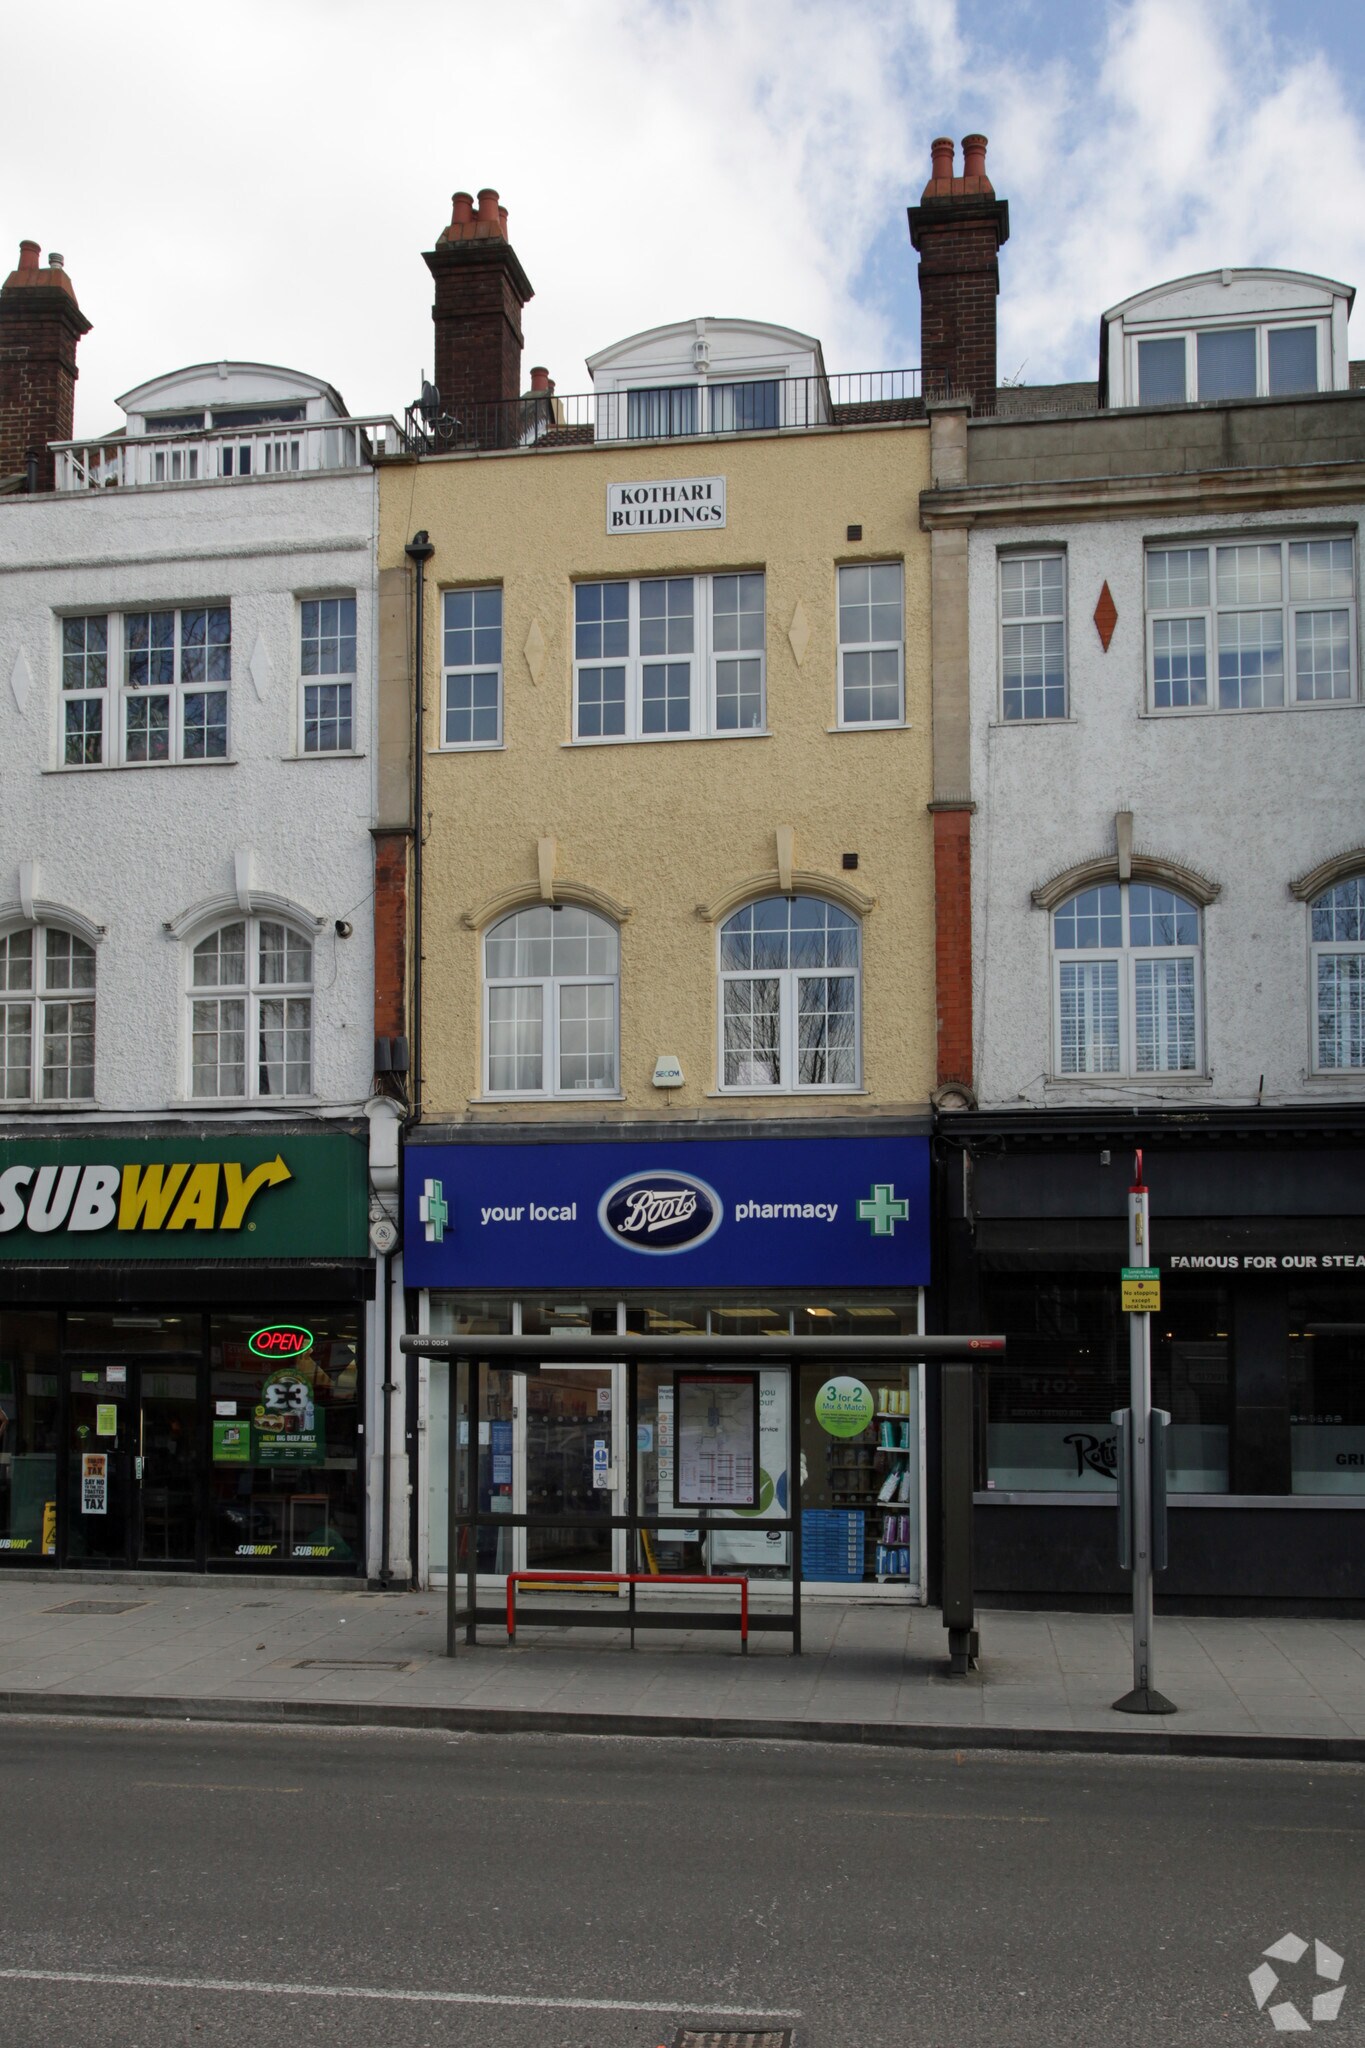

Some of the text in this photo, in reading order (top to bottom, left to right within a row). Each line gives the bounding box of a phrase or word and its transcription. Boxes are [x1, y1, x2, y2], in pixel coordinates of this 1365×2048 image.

[621, 484, 712, 505] KOTHARI
[612, 505, 722, 526] BUILDINGS
[655, 1070, 680, 1078] SECOM
[0, 1154, 291, 1233] SUBWAY
[480, 1189, 839, 1233] your local Boots pharmacy
[1170, 1255, 1365, 1268] FAMOUS FOR OUR STEA
[257, 1332, 304, 1351] OPEN
[265, 1383, 309, 1409] £3
[760, 1389, 776, 1398] you
[827, 1386, 863, 1402] 3 for 2
[845, 1403, 867, 1411] Match
[301, 1434, 316, 1442] MELT
[1336, 1453, 1364, 1465] GRI
[84, 1498, 104, 1510] TAX
[235, 1544, 278, 1556] SUBWAY
[292, 1546, 335, 1557] SUBWAY
